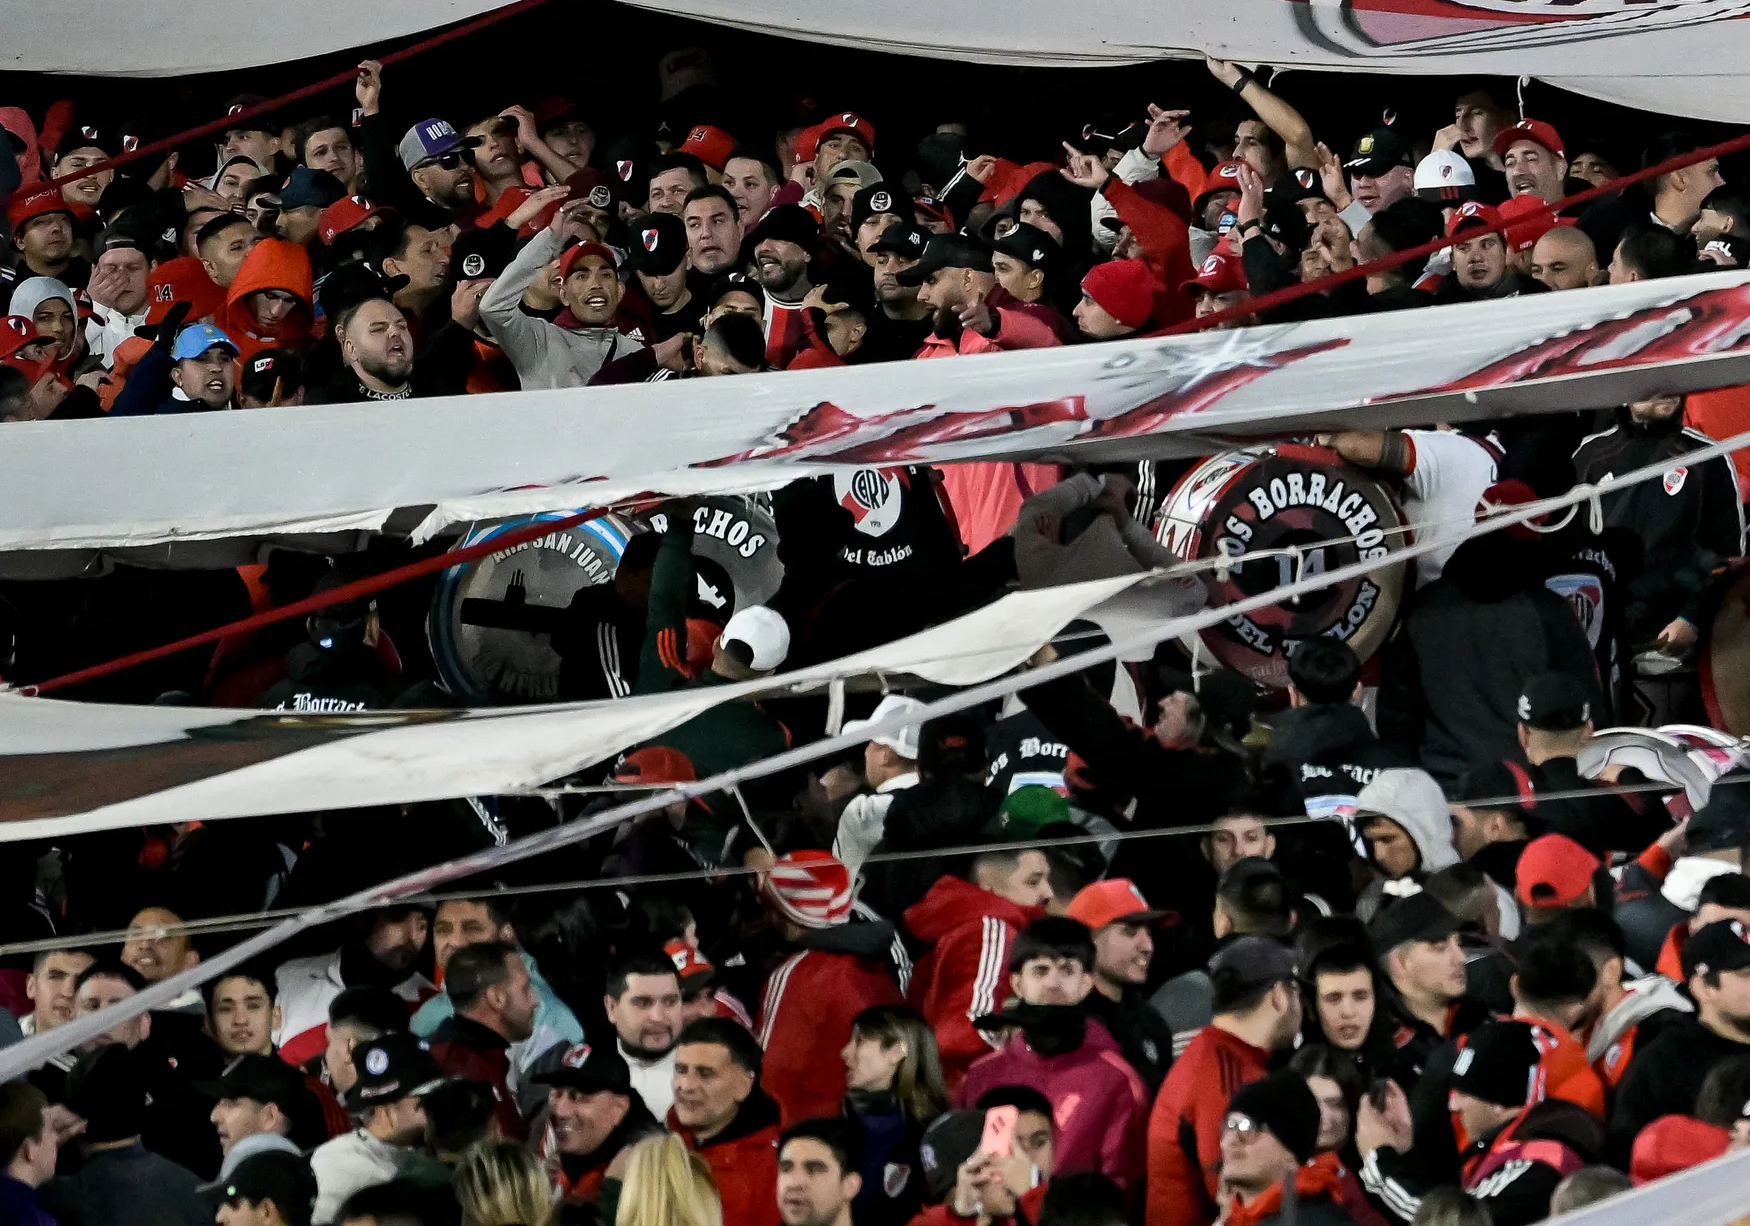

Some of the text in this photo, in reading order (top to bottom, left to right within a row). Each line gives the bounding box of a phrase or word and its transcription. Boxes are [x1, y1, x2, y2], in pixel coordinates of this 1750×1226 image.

[155, 283, 174, 302] 14
[1249, 472, 1388, 563] BORRACHOS
[533, 531, 567, 555] SAN
[570, 542, 610, 584] JUAN
[1274, 549, 1327, 587] 14
[1283, 577, 1378, 656] TLON
